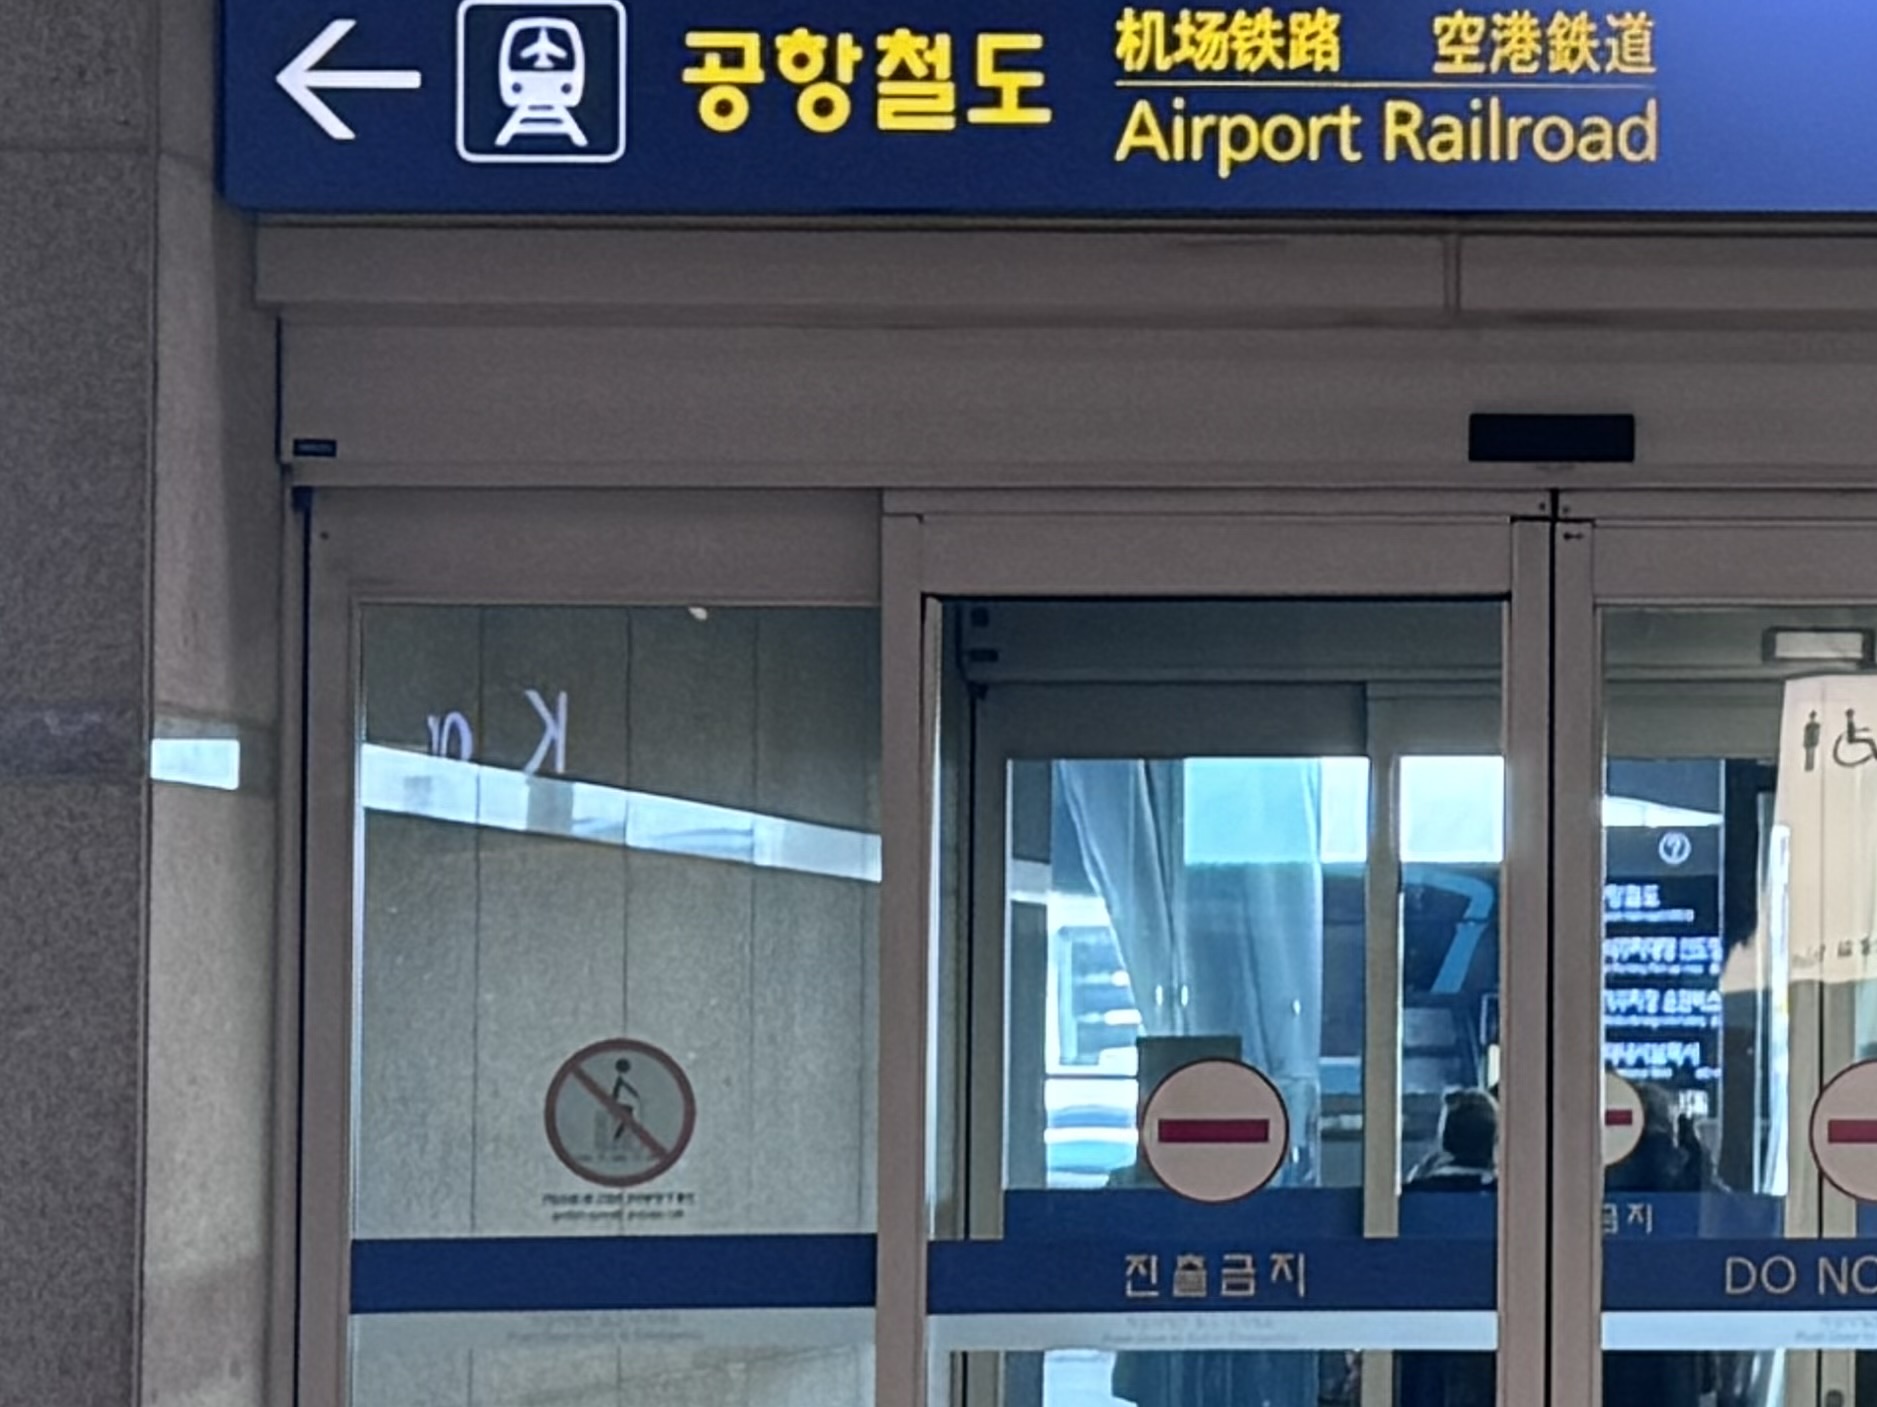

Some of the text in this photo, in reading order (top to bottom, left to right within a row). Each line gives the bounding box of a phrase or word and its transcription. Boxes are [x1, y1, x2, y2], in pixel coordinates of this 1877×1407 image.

[1115, 7, 1341, 73] 机场铁路
[1433, 9, 1657, 74] 空港鉄道
[682, 27, 1052, 133] 공항철도
[1115, 96, 1657, 179] Airport Railroad
[1125, 1253, 1305, 1298] 진출금지
[1725, 1255, 1797, 1294] DO
